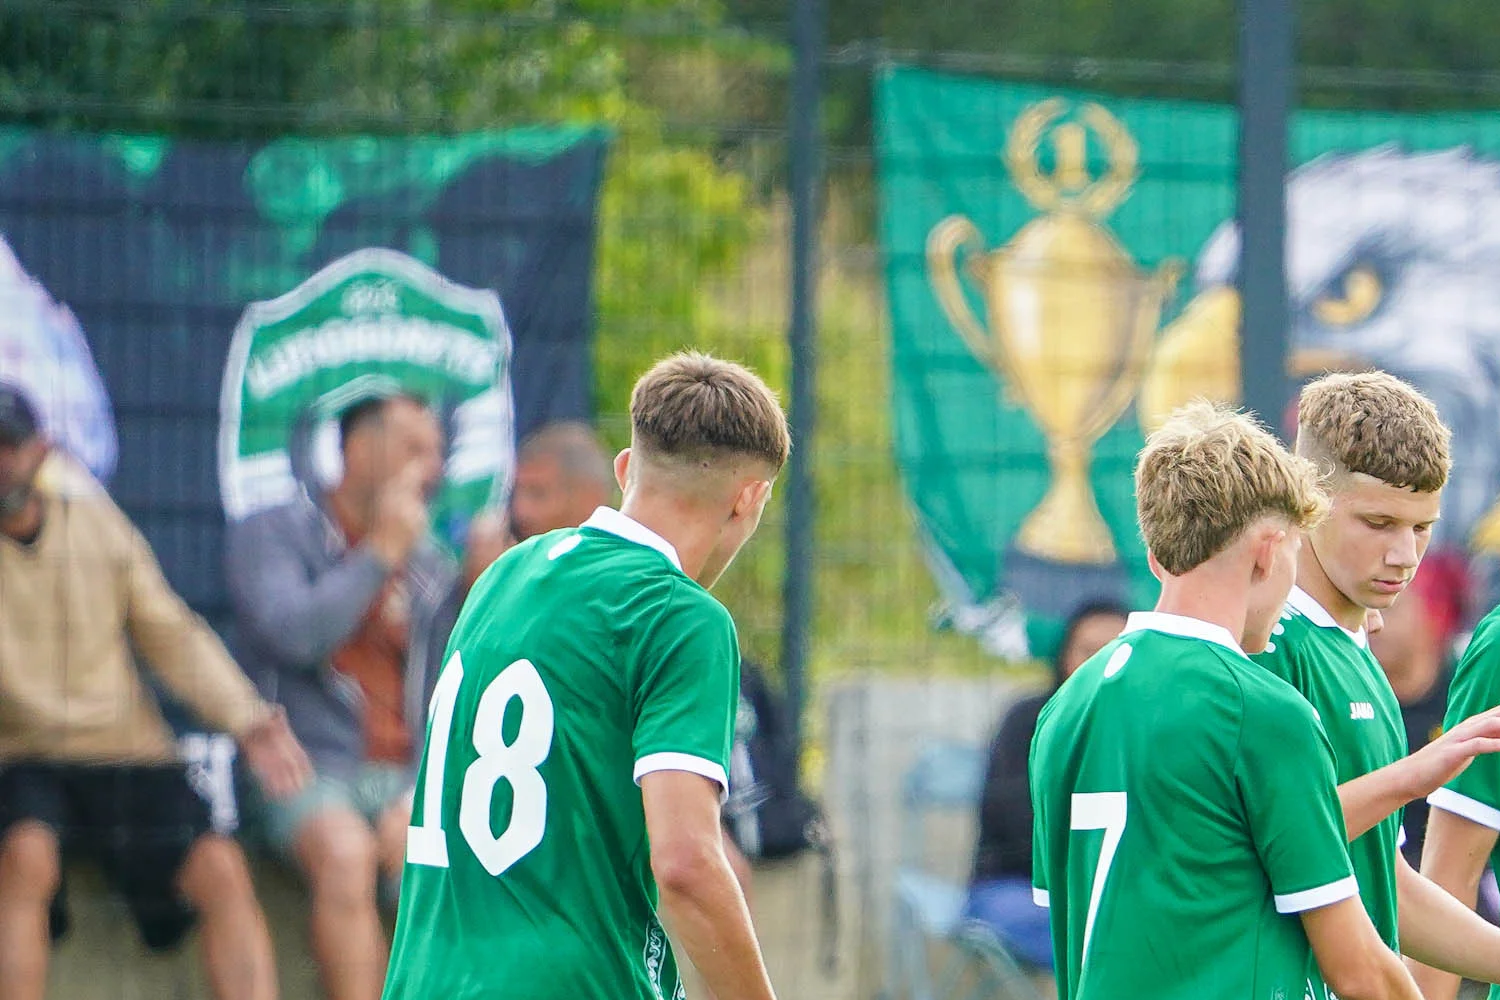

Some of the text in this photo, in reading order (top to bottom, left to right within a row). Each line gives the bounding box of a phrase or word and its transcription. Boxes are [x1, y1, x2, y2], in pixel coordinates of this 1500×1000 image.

[407, 650, 554, 876] 18
[1350, 702, 1375, 720] JAKO
[1070, 791, 1127, 972] 7
